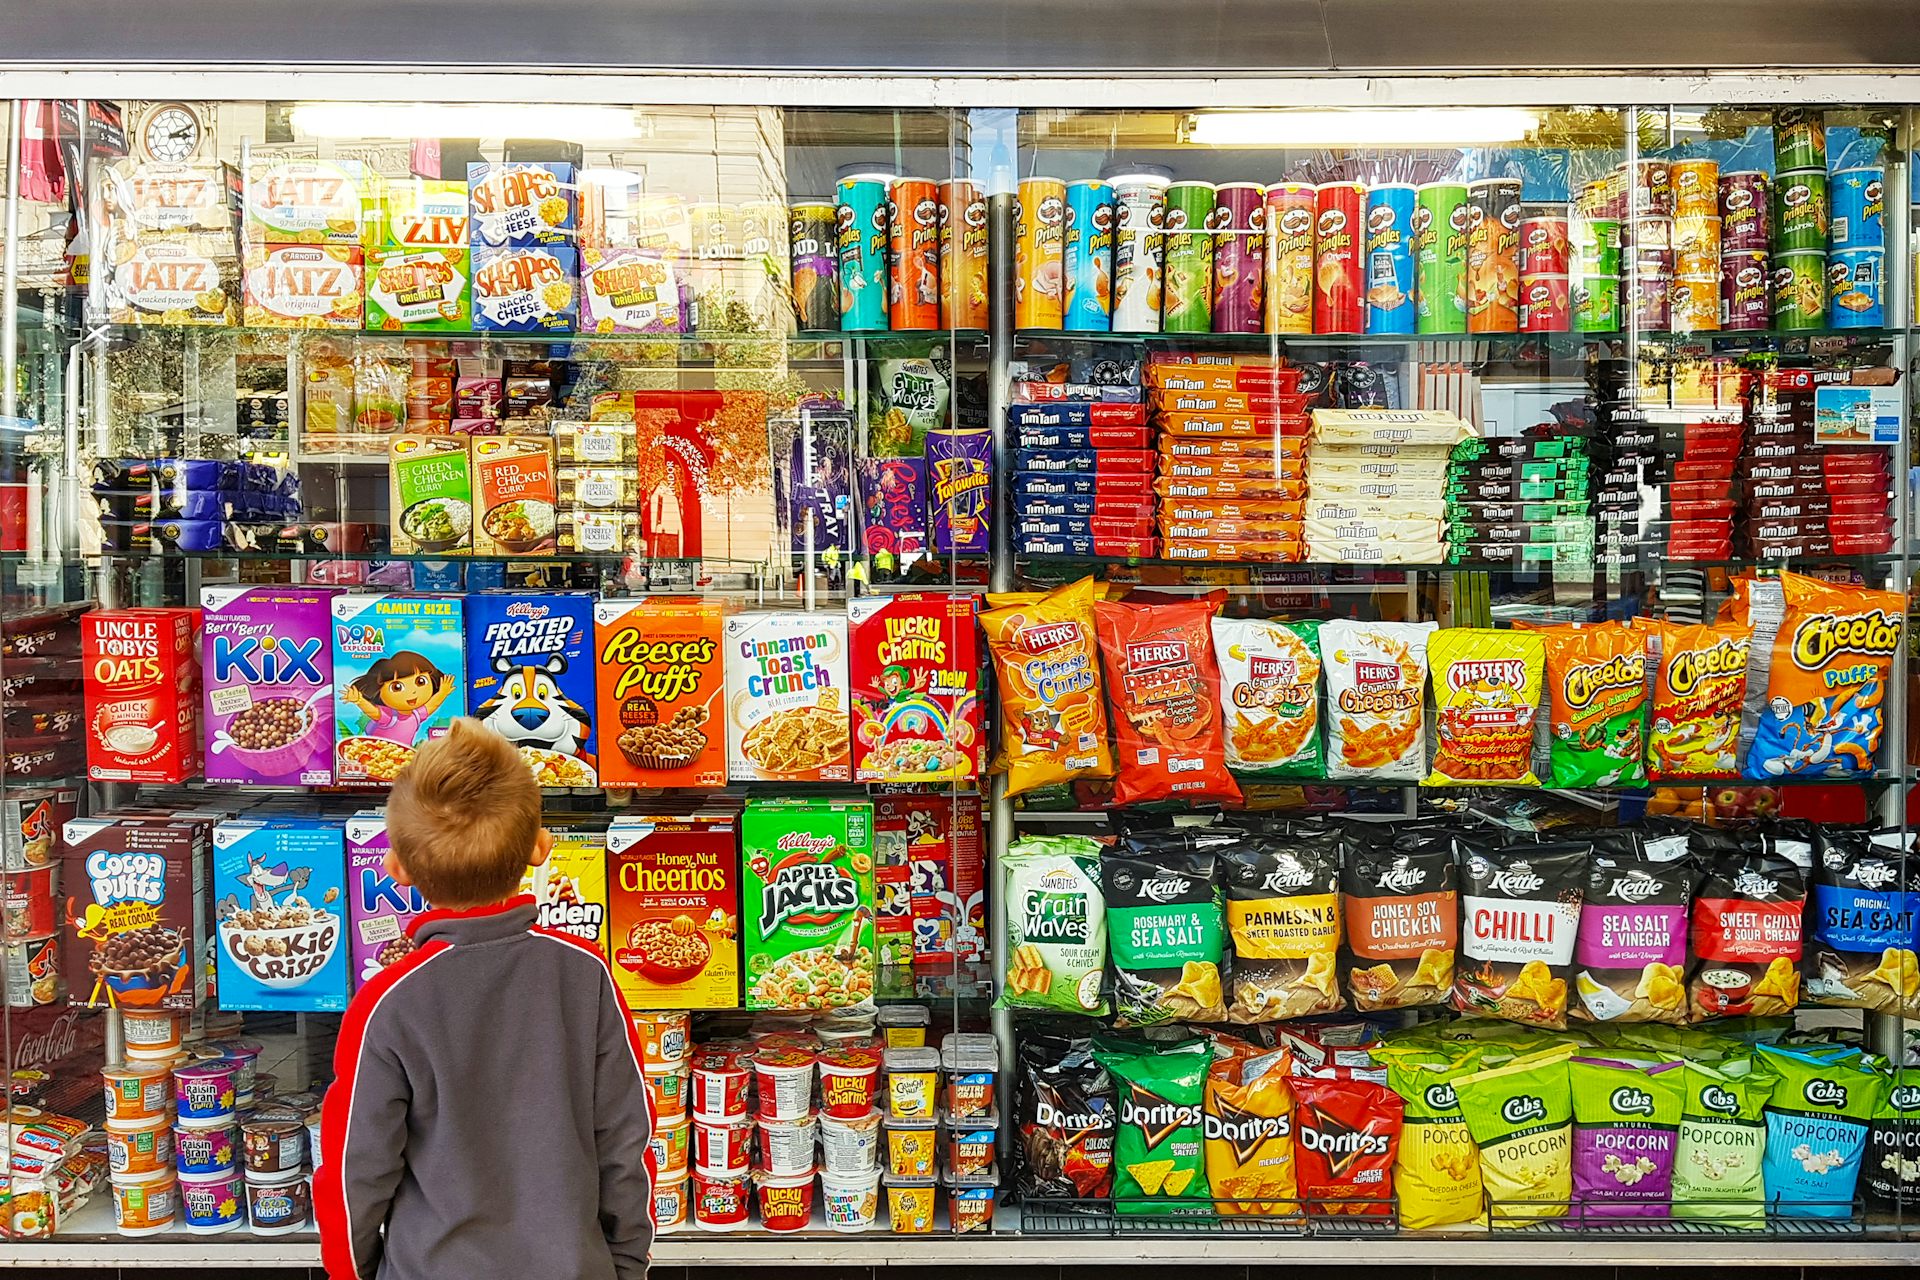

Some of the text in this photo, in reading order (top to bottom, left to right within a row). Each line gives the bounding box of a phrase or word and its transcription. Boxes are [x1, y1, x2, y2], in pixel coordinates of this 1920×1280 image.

[1724, 206, 1757, 229] Pringles
[1783, 203, 1815, 224] Pringles
[1735, 222, 1755, 234] BBQ
[130, 263, 207, 293] JATZ
[263, 267, 342, 298] JATZ
[139, 295, 193, 306] cracked pepper
[285, 299, 320, 311] original
[401, 290, 441, 304] ORIGINALS
[499, 294, 533, 310] NACHO
[497, 302, 541, 321] CHEESE
[892, 373, 934, 391] Grain
[412, 461, 452, 477] GREEN
[495, 465, 520, 477] RED
[803, 435, 822, 489] MILK
[414, 470, 464, 485] CHICKEN
[497, 471, 547, 486] CHICKEN
[415, 483, 443, 493] CURRY
[498, 484, 526, 495] CURRY
[937, 472, 989, 503] Favourites
[815, 486, 838, 535] TRAY
[376, 603, 451, 615] FAMILY SIZE
[507, 603, 549, 618] Kellogg's
[96, 622, 157, 639] UNCLE
[206, 623, 273, 636] Berry Berry
[336, 625, 384, 646] DORA
[486, 617, 574, 642] FROSTED
[885, 616, 941, 643] Lucky
[1028, 625, 1075, 648] HERR'S
[96, 639, 158, 656] TOBYS
[491, 635, 565, 658] FLAKES
[602, 628, 718, 664] Reese's
[741, 632, 828, 658] Cinnamon
[1795, 613, 1902, 667] Cheetos
[878, 639, 946, 665] Charms
[1132, 645, 1181, 662] HERR'S
[95, 658, 160, 683] OATS
[757, 650, 814, 676] Toast
[1026, 654, 1087, 683] Cheese
[1253, 661, 1292, 675] HERR'S
[614, 664, 700, 702] Puffs
[748, 665, 830, 697] Crunch
[930, 670, 968, 687] 3 new
[1447, 661, 1526, 687] CHESTER'S
[1566, 656, 1645, 707] Cheetos
[1825, 665, 1879, 687] Puffs
[213, 688, 247, 699] Kid-Tested
[1037, 669, 1095, 704] Curls
[1135, 682, 1194, 704] PIZZA
[110, 703, 148, 713] QUICK
[1166, 705, 1197, 717] Cheese
[1474, 713, 1507, 721] FRIES
[1571, 702, 1605, 723] cheddar
[1172, 715, 1194, 725] Curls
[114, 742, 172, 766] Natural OAT ENERGY
[779, 832, 835, 849] Kellogg's
[88, 852, 162, 879] Cocoa
[656, 853, 717, 867] Honey Nut
[619, 862, 725, 892] Cheerios
[777, 865, 835, 883] APPLE
[1040, 876, 1077, 889] SUNBITES
[1260, 871, 1314, 895] Kettle
[94, 875, 162, 904] Puffs
[1136, 879, 1191, 903] Kettle
[1488, 871, 1545, 897] Kettle
[1607, 878, 1663, 903] Kettle
[678, 897, 707, 906] OATS
[762, 878, 855, 930] JACKS
[1023, 892, 1089, 915] Grain
[1373, 901, 1437, 920] HONEY SOY
[1854, 898, 1890, 910] ORIGINAL
[109, 912, 155, 929] REAL COCOA!
[113, 908, 128, 917] MADE
[1133, 913, 1200, 928] ROSEMARY &
[1245, 907, 1335, 926] PARMESAN &
[1720, 913, 1758, 928] SWEET
[1828, 907, 1863, 929] SEA
[1023, 914, 1090, 938] Waves
[1247, 925, 1336, 939] SWEET ROASTED GARLIC
[1371, 916, 1441, 939] CHICKEN
[1475, 909, 1554, 942] CHILLI
[1603, 915, 1668, 932] SEA SALT
[1131, 926, 1203, 947] SEA SALT
[1602, 933, 1670, 947] & VINEGAR
[1723, 929, 1800, 942] & SOUR CREAM
[1061, 948, 1099, 957] SOUR CREAM
[1146, 951, 1175, 959] Australian
[1176, 950, 1204, 958] Rosemary
[186, 1086, 216, 1095] Raisin
[190, 1093, 214, 1103] Bran
[1807, 1081, 1845, 1106] Cobs
[1504, 1098, 1543, 1121] Cobs
[1613, 1088, 1651, 1113] Cobs
[1036, 1102, 1113, 1129] Doritos
[1121, 1099, 1202, 1125] Doritos
[1805, 1112, 1843, 1121] NATURAL
[1301, 1125, 1389, 1153] Doritos
[1511, 1126, 1550, 1139] NATURAL
[1595, 1134, 1669, 1150] POPCORN
[1784, 1122, 1857, 1143] POPCORN
[1498, 1133, 1567, 1163] POPCORN
[1357, 1169, 1383, 1177] CHEESE
[766, 1188, 802, 1203] Lucky
[1527, 1192, 1555, 1200] BUTTER
[255, 1206, 292, 1218] KRISPIES
[765, 1203, 804, 1218] Charms
